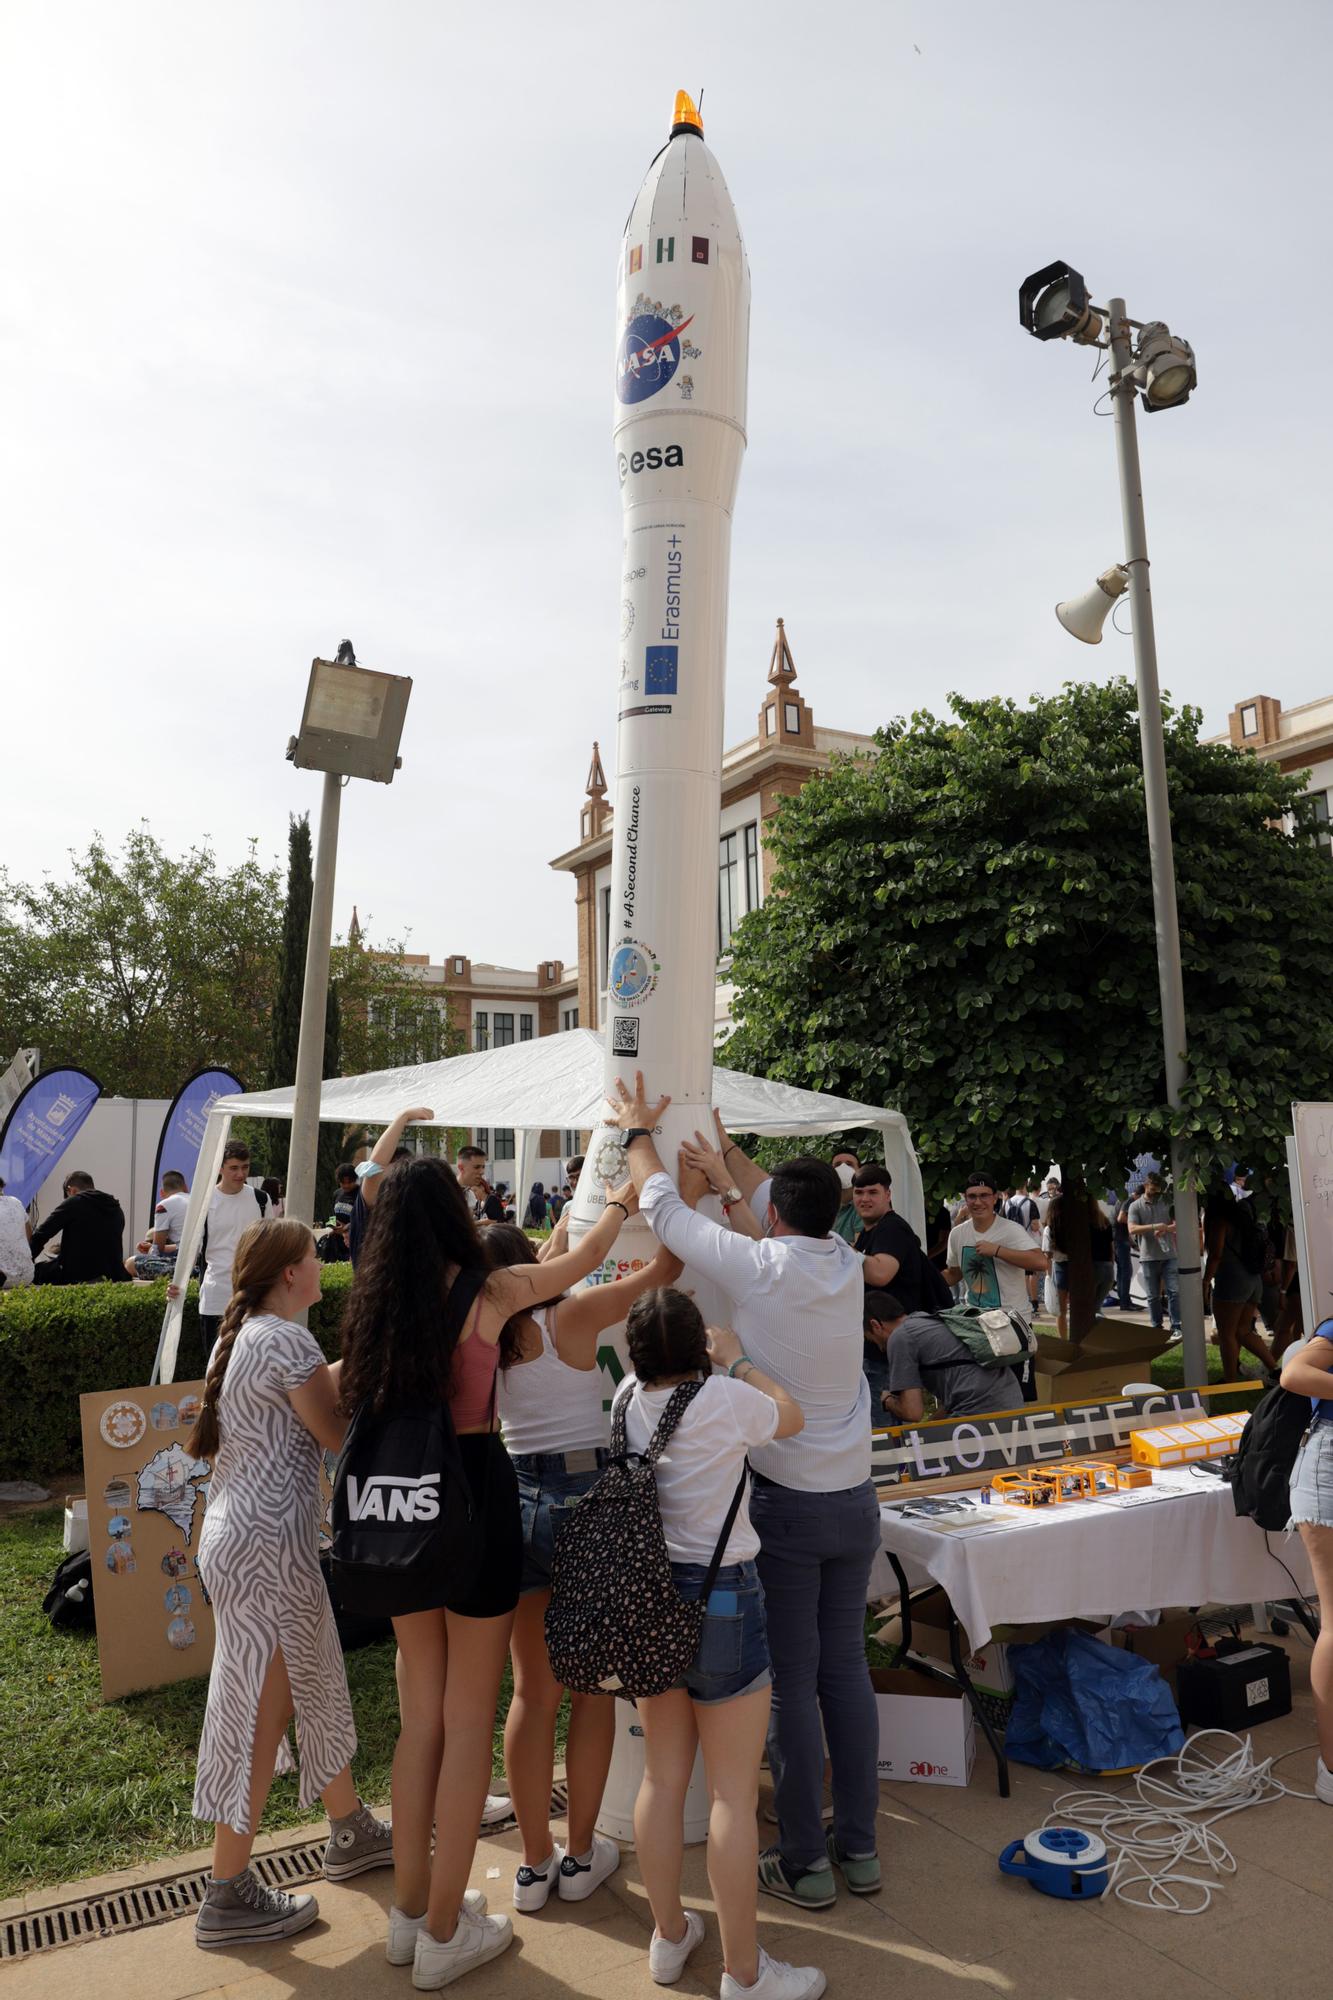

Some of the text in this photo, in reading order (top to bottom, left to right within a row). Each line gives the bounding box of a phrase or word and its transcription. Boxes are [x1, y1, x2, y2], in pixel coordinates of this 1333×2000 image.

[618, 343, 676, 377] NASA
[630, 444, 684, 474] esa
[662, 534, 682, 640] Erasmus+
[909, 1412, 1064, 1477] LOVE
[346, 1472, 441, 1523] VANS
